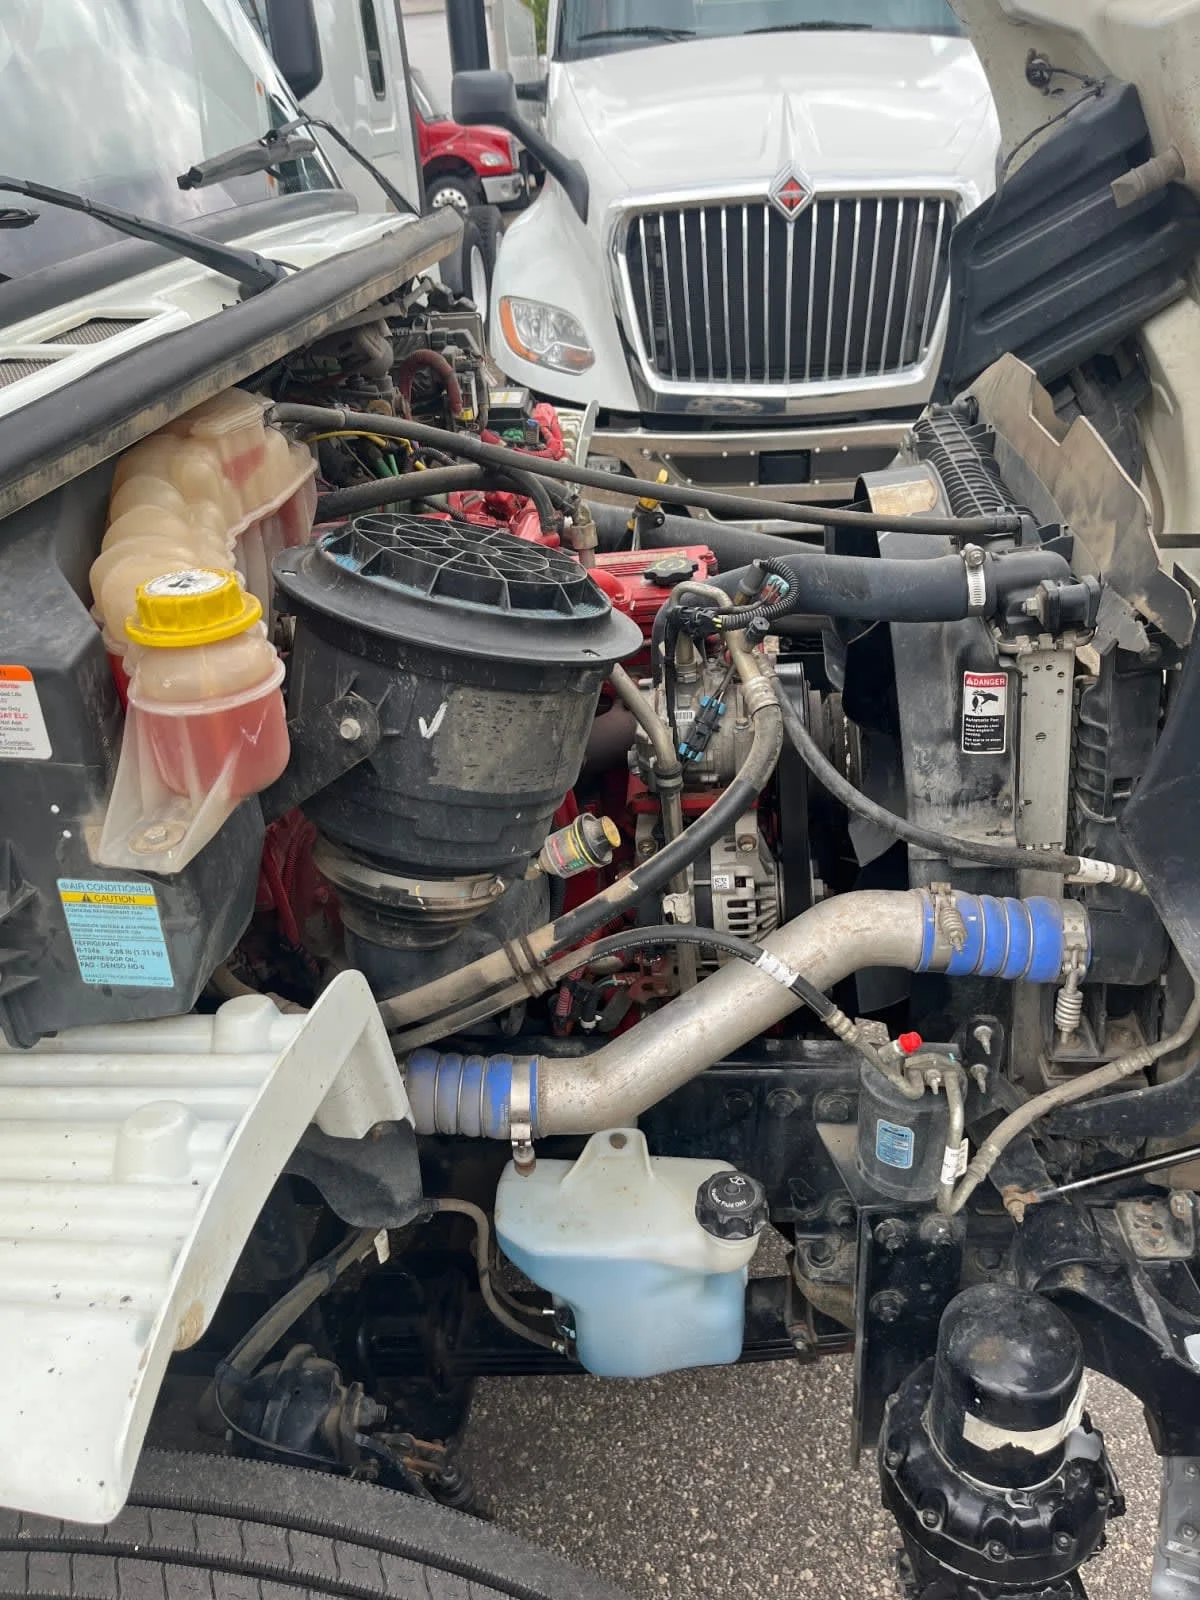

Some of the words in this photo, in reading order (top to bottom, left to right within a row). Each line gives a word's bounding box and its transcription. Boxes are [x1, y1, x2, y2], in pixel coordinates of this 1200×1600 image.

[973, 678, 1005, 686] DANGER
[86, 883, 152, 893] CONDITIONER
[94, 895, 136, 904] CAUTION
